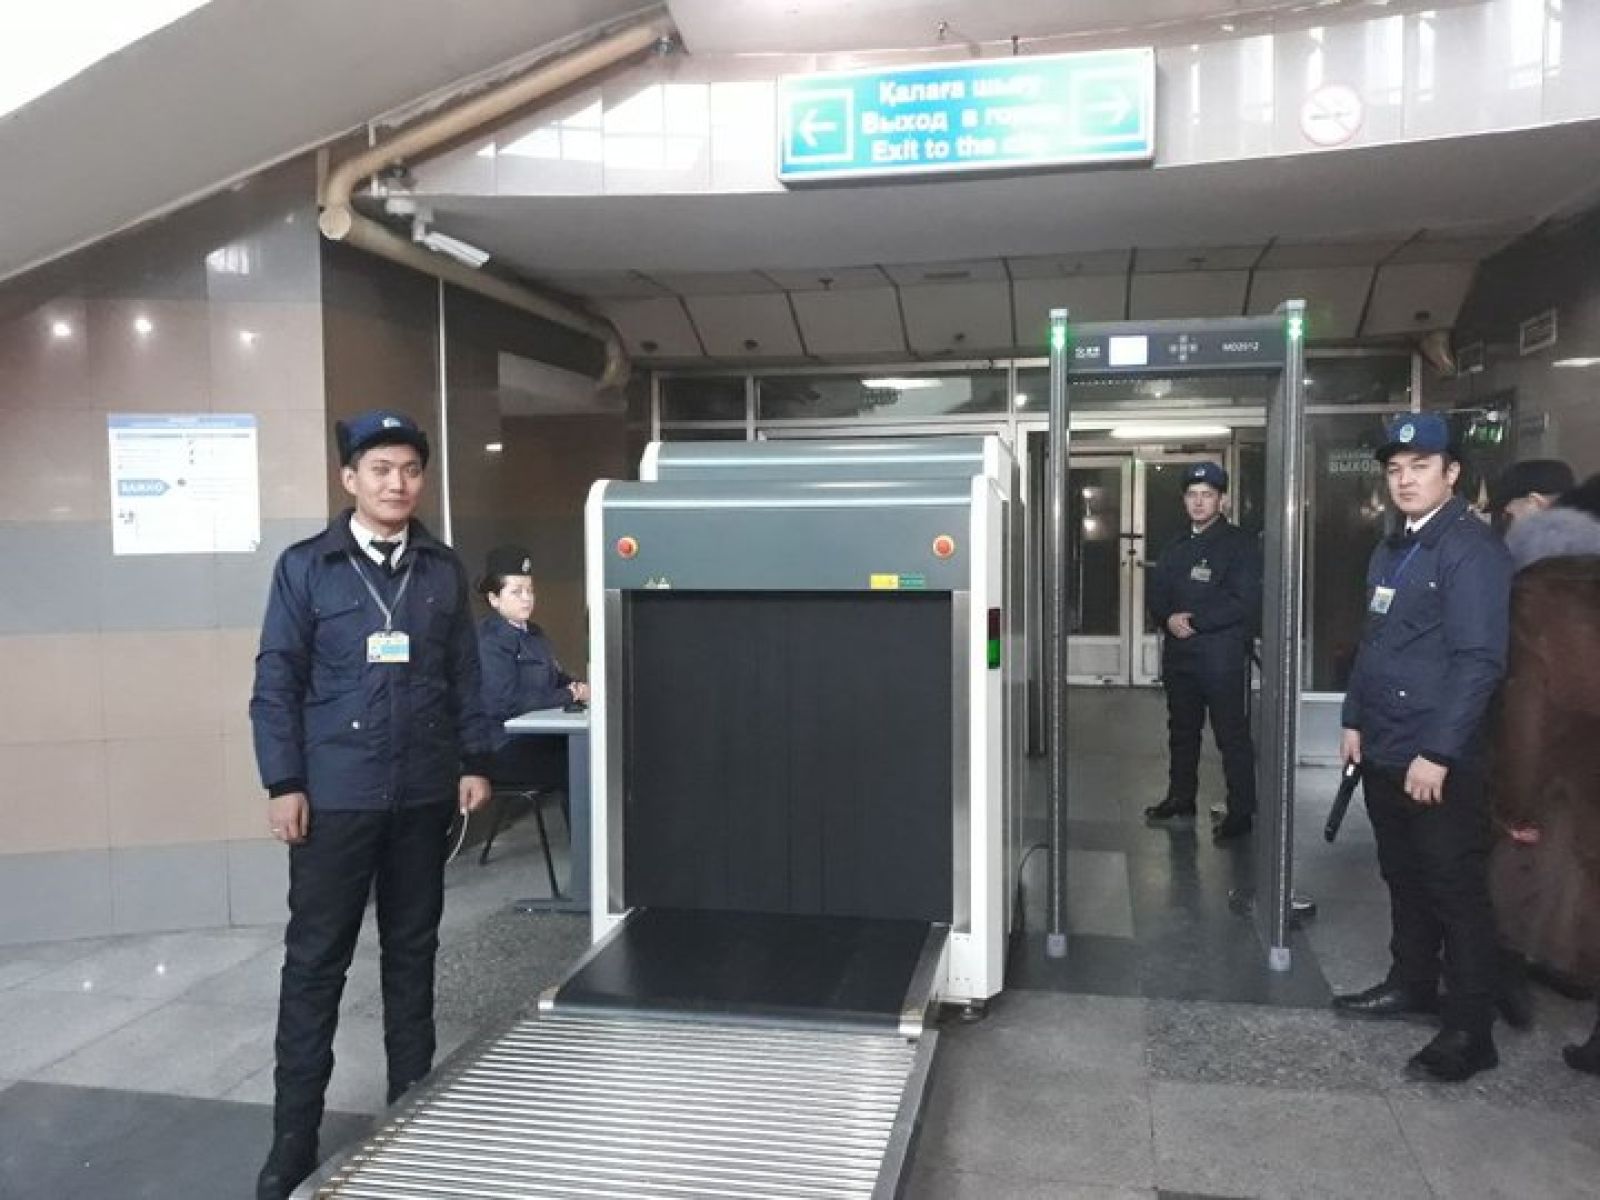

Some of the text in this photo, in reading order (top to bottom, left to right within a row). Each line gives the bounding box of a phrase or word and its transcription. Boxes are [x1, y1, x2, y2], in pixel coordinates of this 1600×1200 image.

[861, 110, 948, 134] Выход
[871, 139, 919, 161] Exit
[924, 138, 950, 159] to
